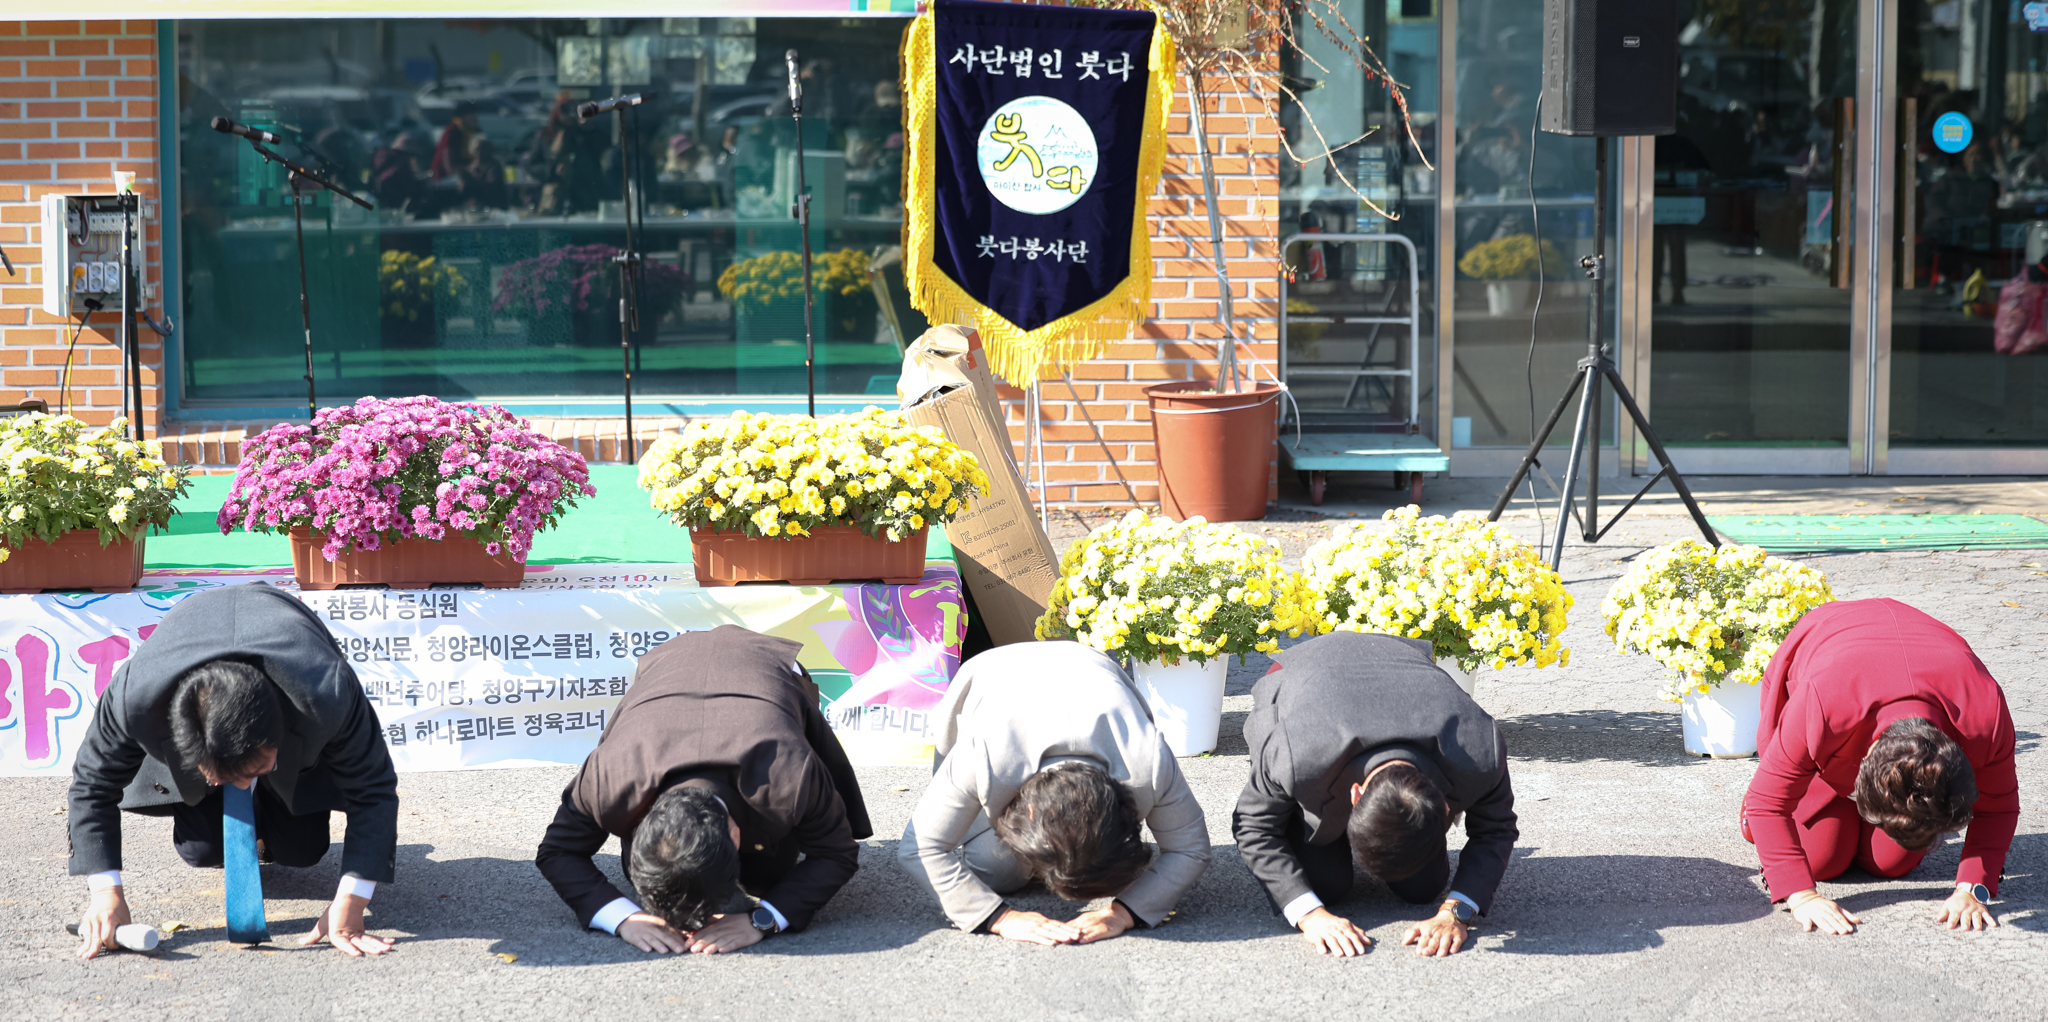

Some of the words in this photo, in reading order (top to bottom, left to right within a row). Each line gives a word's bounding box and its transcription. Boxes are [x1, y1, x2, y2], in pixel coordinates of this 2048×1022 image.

[949, 43, 1063, 79] 사단법인
[1075, 50, 1134, 82] 붓다
[990, 113, 1087, 194] 붓다
[994, 181, 1020, 191] 마이산
[976, 235, 1089, 263] 붓다봉사단
[993, 542, 1009, 552] China
[327, 594, 389, 621] 참봉사
[397, 593, 458, 620] 동심원
[427, 632, 600, 662] 청양라이온스클럽,
[365, 680, 472, 706] 백년추어탕,
[483, 676, 628, 704] 청양구기자조합
[381, 723, 407, 746] 협
[415, 716, 516, 745] 하나로마트
[523, 709, 605, 737] 정육코너
[870, 706, 934, 738] 합니다.
